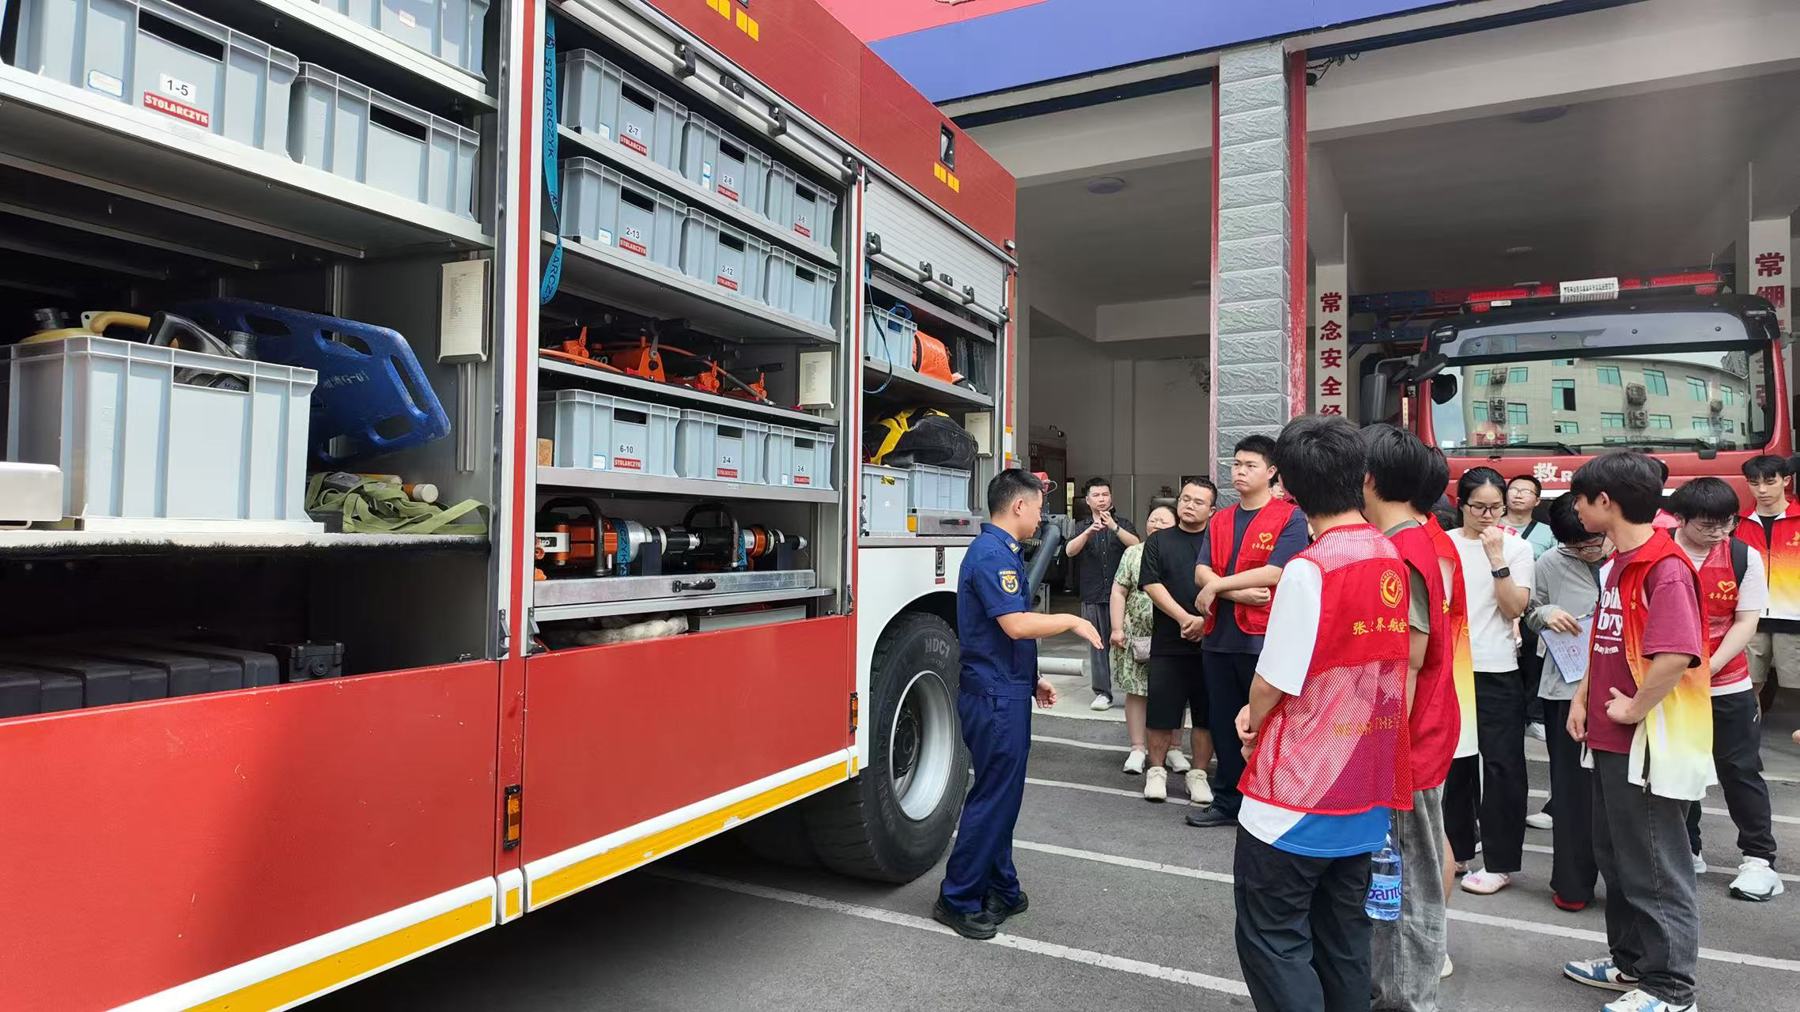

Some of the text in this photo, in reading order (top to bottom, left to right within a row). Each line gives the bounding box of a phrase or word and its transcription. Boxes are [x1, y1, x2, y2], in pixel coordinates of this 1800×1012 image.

[167, 79, 189, 97] 1-5
[144, 93, 208, 125] STOLARCZYK
[628, 124, 640, 136] 2-7
[1319, 291, 1343, 418] 常念安全经
[1533, 462, 1558, 482] 救
